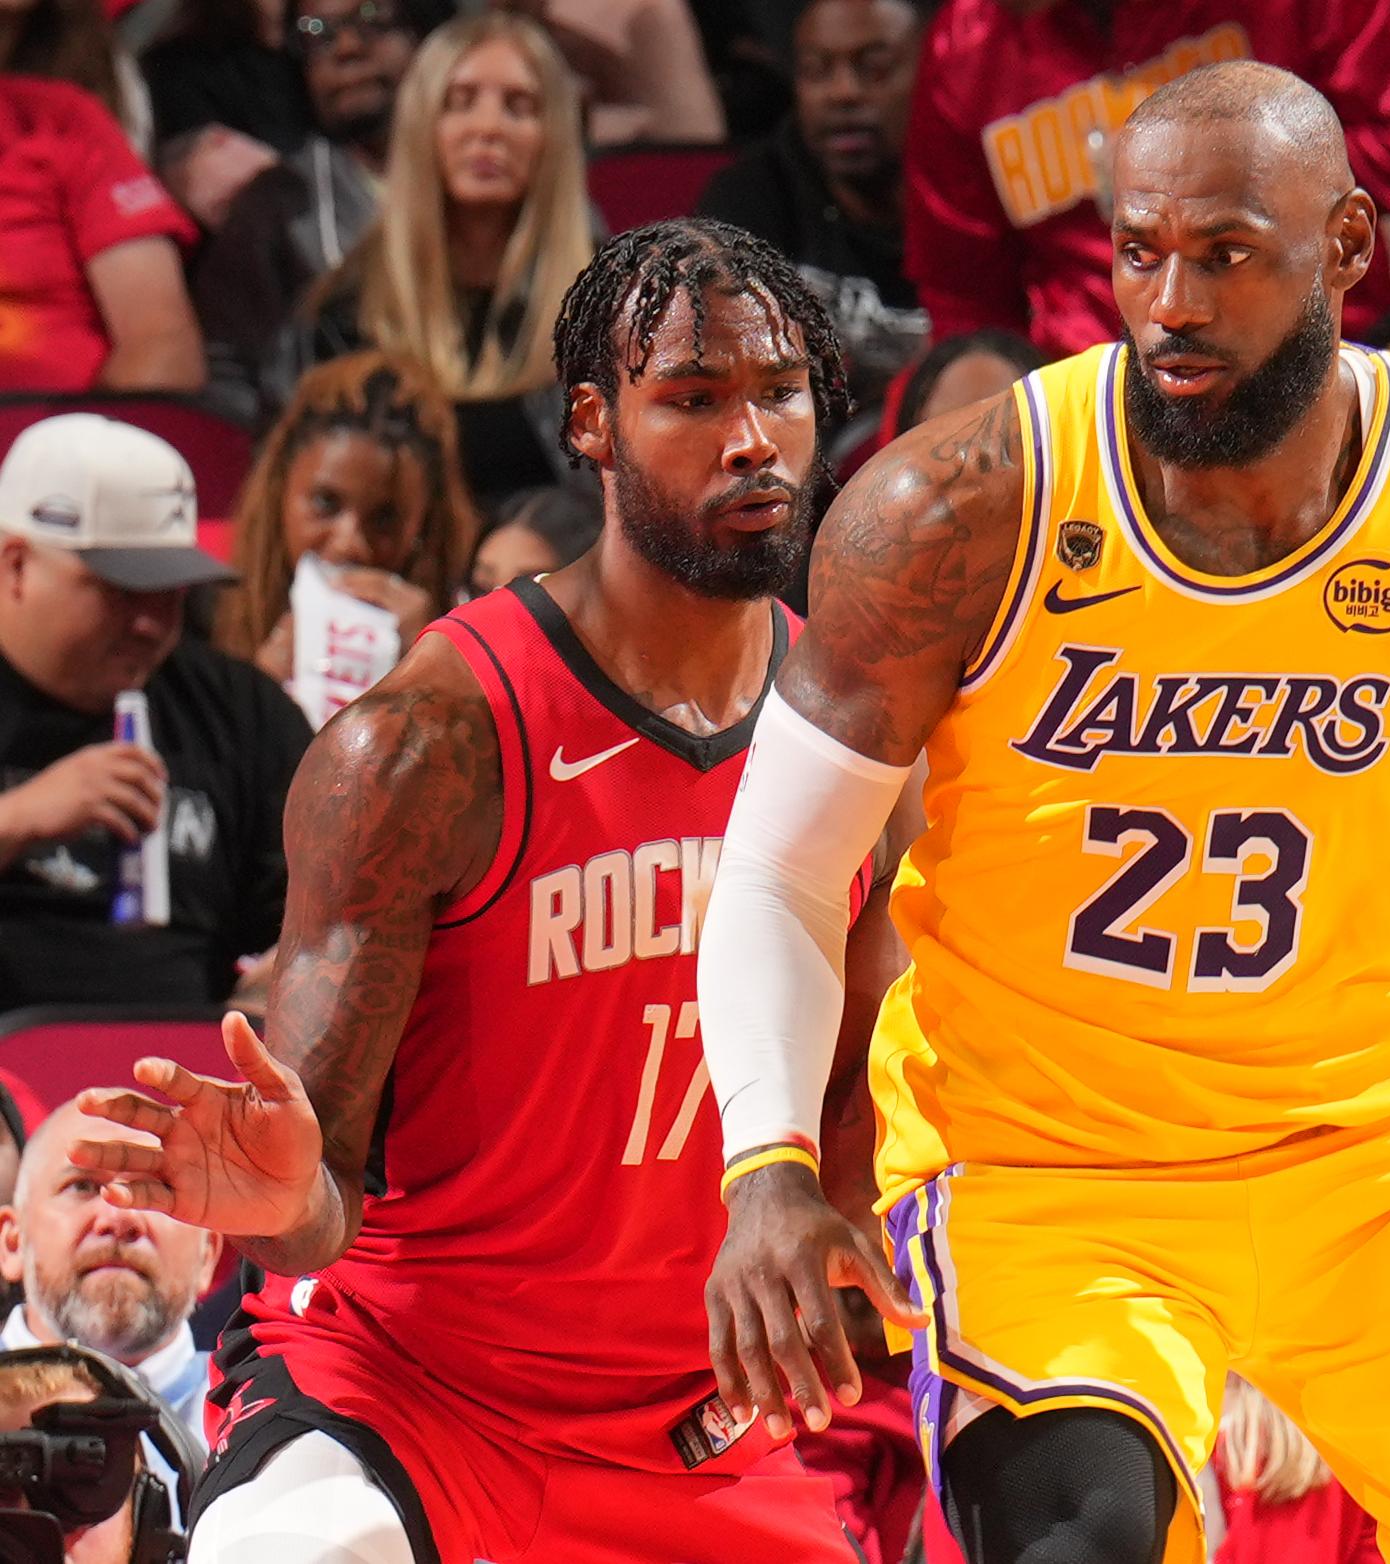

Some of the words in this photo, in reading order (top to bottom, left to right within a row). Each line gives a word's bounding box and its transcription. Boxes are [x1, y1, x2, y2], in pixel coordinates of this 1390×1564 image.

[1345, 604, 1380, 618] 비비고
[527, 836, 725, 987] ROCK
[1062, 804, 1315, 993] 23
[620, 1001, 712, 1165] 17
